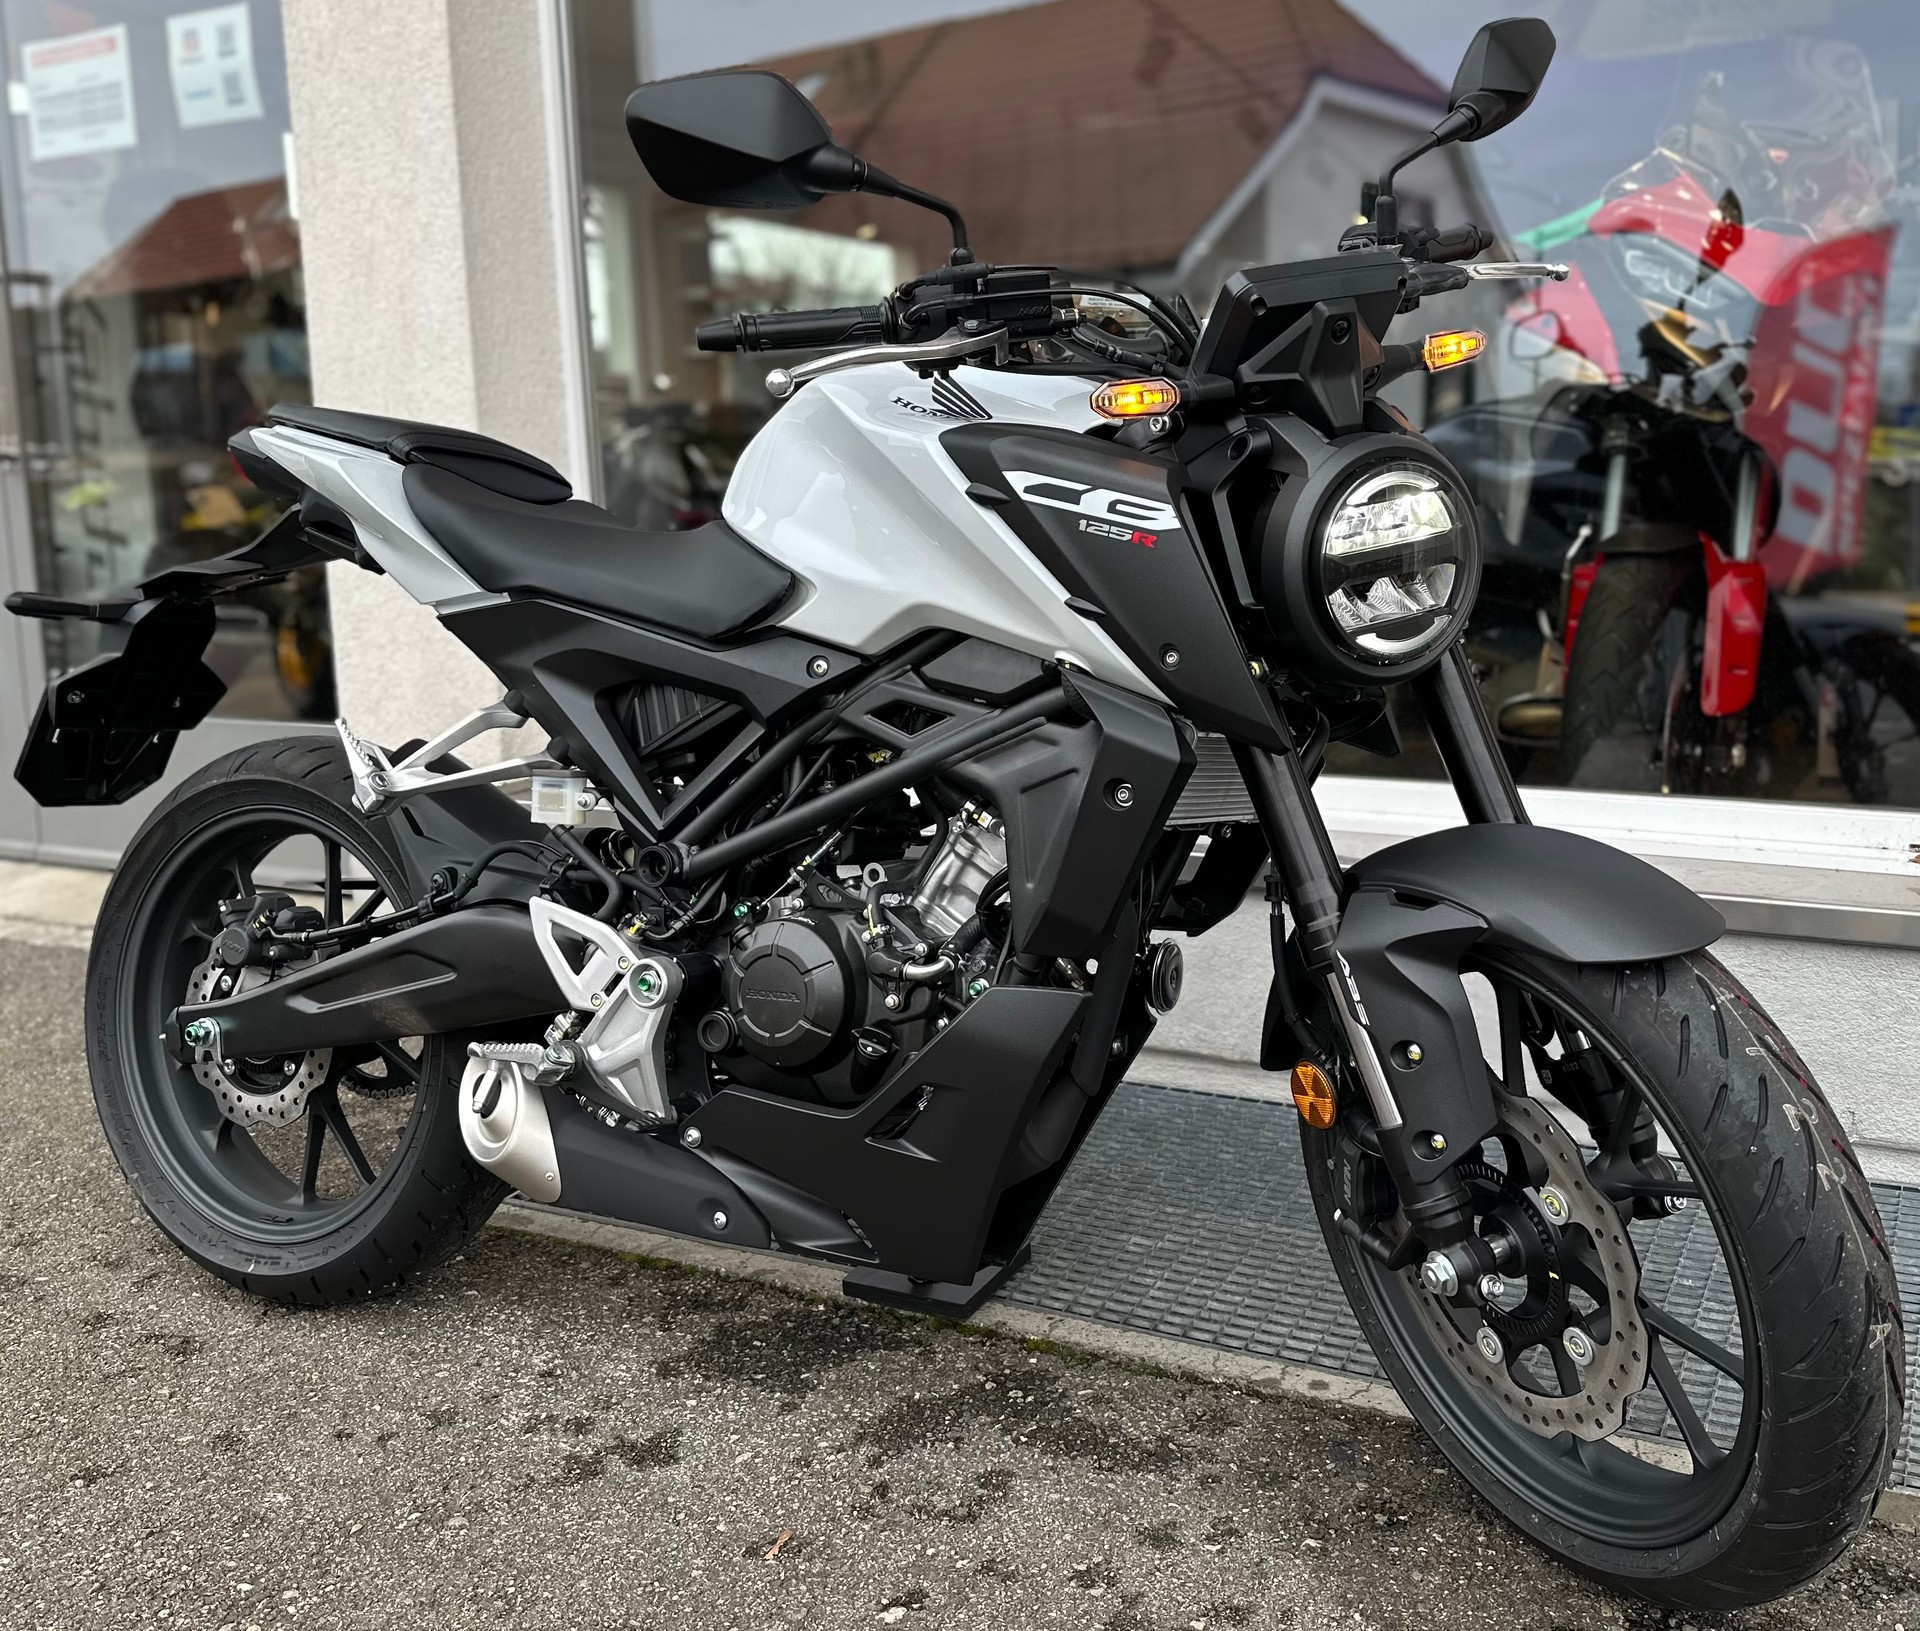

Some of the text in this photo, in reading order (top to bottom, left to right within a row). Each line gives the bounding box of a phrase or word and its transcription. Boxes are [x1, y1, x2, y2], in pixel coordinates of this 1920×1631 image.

[1001, 470, 1182, 531] CB
[1078, 518, 1158, 549] 125R
[745, 988, 801, 1003] HONDA
[1336, 949, 1370, 1026] ABS
